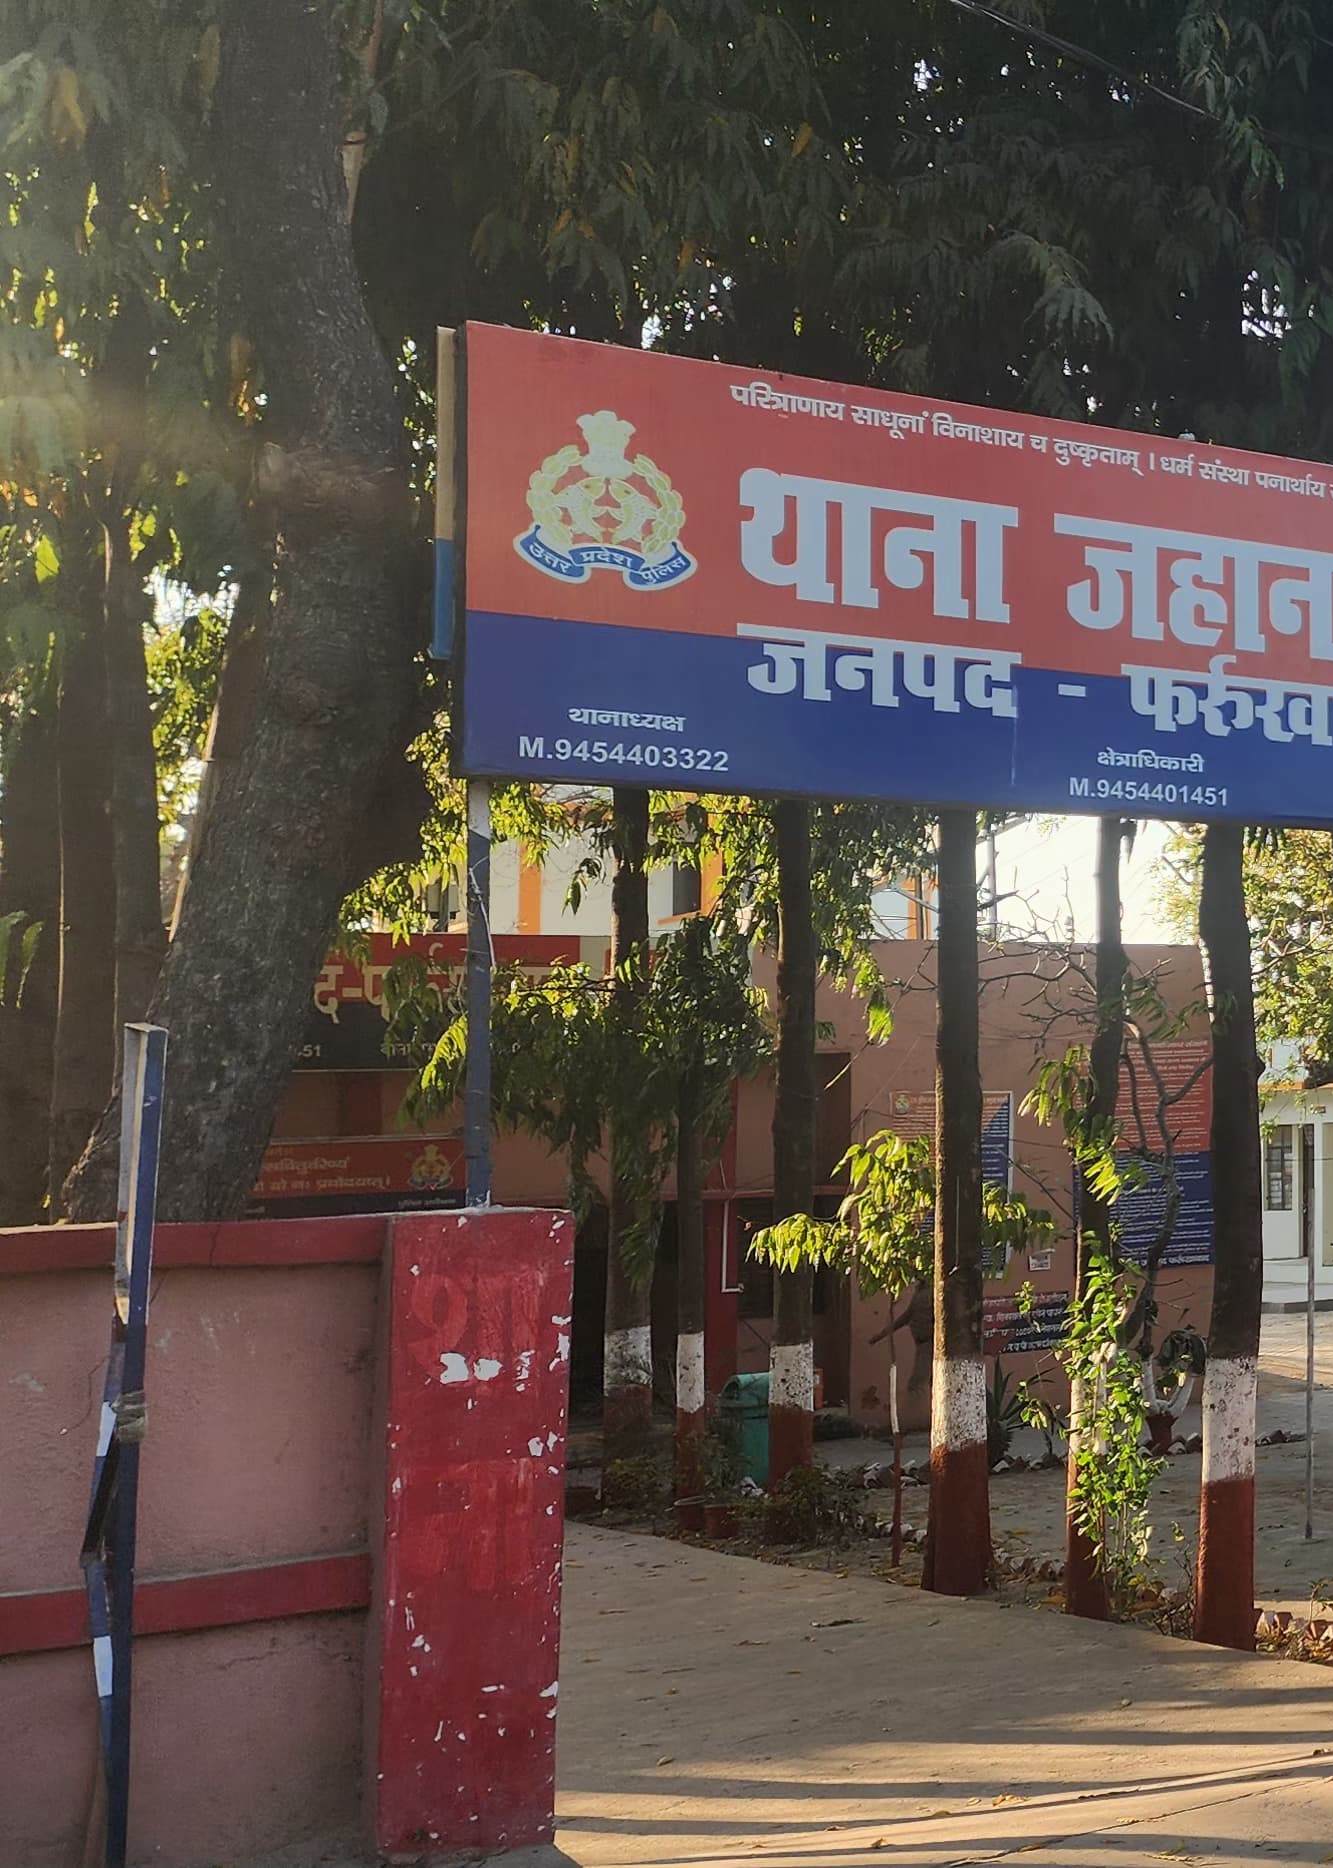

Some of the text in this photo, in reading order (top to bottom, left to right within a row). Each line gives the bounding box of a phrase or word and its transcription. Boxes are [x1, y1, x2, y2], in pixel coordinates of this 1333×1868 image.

[851, 405, 929, 440] साधूनां
[931, 413, 1024, 449] विनाशाय
[1030, 434, 1048, 453] च
[1053, 438, 1144, 476] दुष्कृताम्
[1160, 453, 1194, 476] धर्म
[1199, 458, 1250, 485] संस्था
[1255, 473, 1325, 498] पनार्थाय
[580, 548, 632, 567] प्रदेश
[739, 468, 1018, 624] थाना
[737, 623, 1021, 718] जनपद
[568, 707, 685, 732] थानाध्यक्ष
[519, 736, 729, 773] M.9454403322
[1097, 747, 1204, 774] क्षेत्राधिकारी
[1069, 777, 1228, 807] M.9454401451
